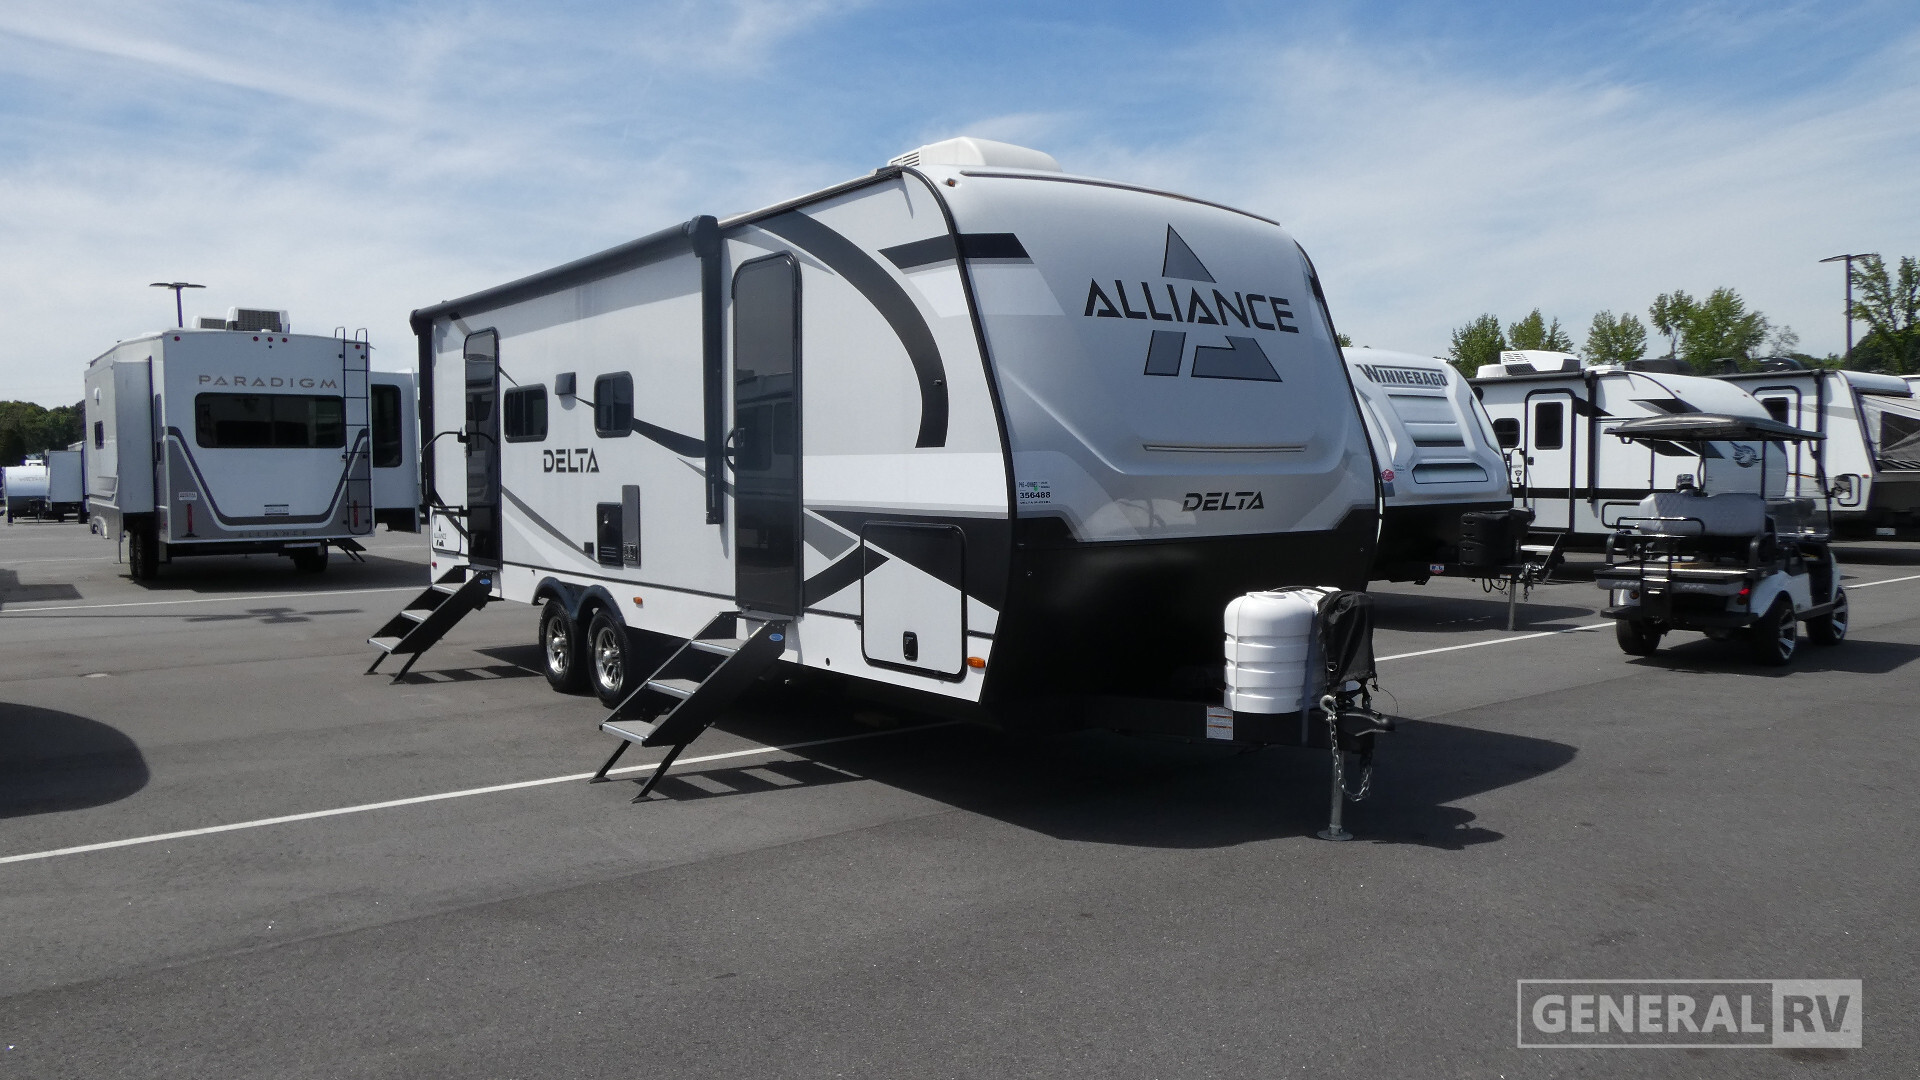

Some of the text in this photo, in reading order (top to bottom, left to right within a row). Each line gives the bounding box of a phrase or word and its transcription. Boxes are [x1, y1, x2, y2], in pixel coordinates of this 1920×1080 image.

[1084, 278, 1299, 334] ALLIANCE
[198, 374, 338, 389] PARADIGM
[1354, 363, 1449, 386] WINNEBAGO
[543, 448, 600, 473] DELTA
[1019, 491, 1051, 499] 356488
[1182, 492, 1265, 512] DELTA
